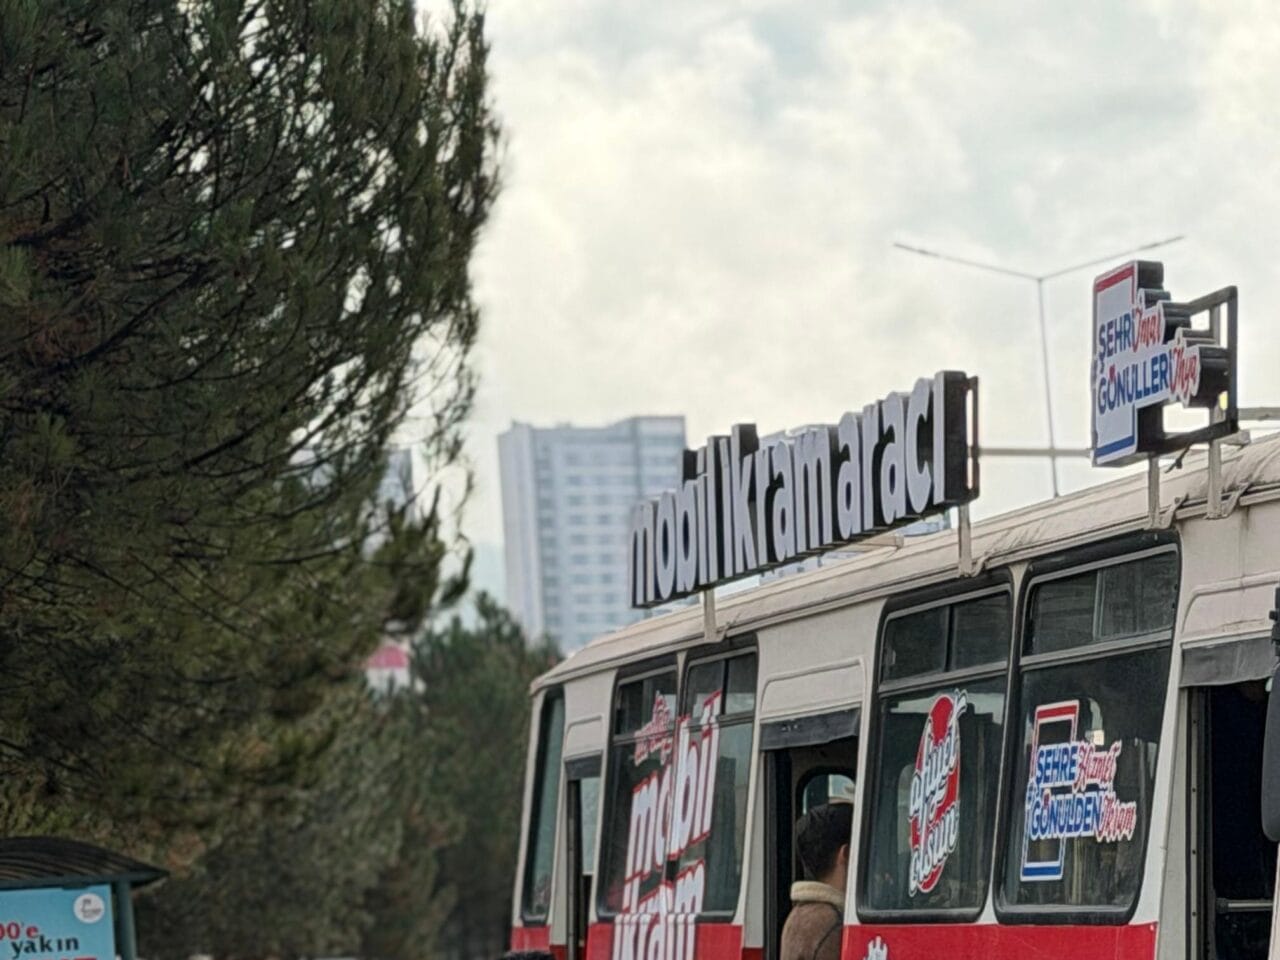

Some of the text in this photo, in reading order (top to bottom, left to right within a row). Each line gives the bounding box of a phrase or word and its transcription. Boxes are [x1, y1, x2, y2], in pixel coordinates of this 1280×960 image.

[628, 436, 718, 606] mobil
[837, 371, 946, 541] aracı
[625, 689, 722, 884] mobil
[12, 934, 79, 959] yakın
